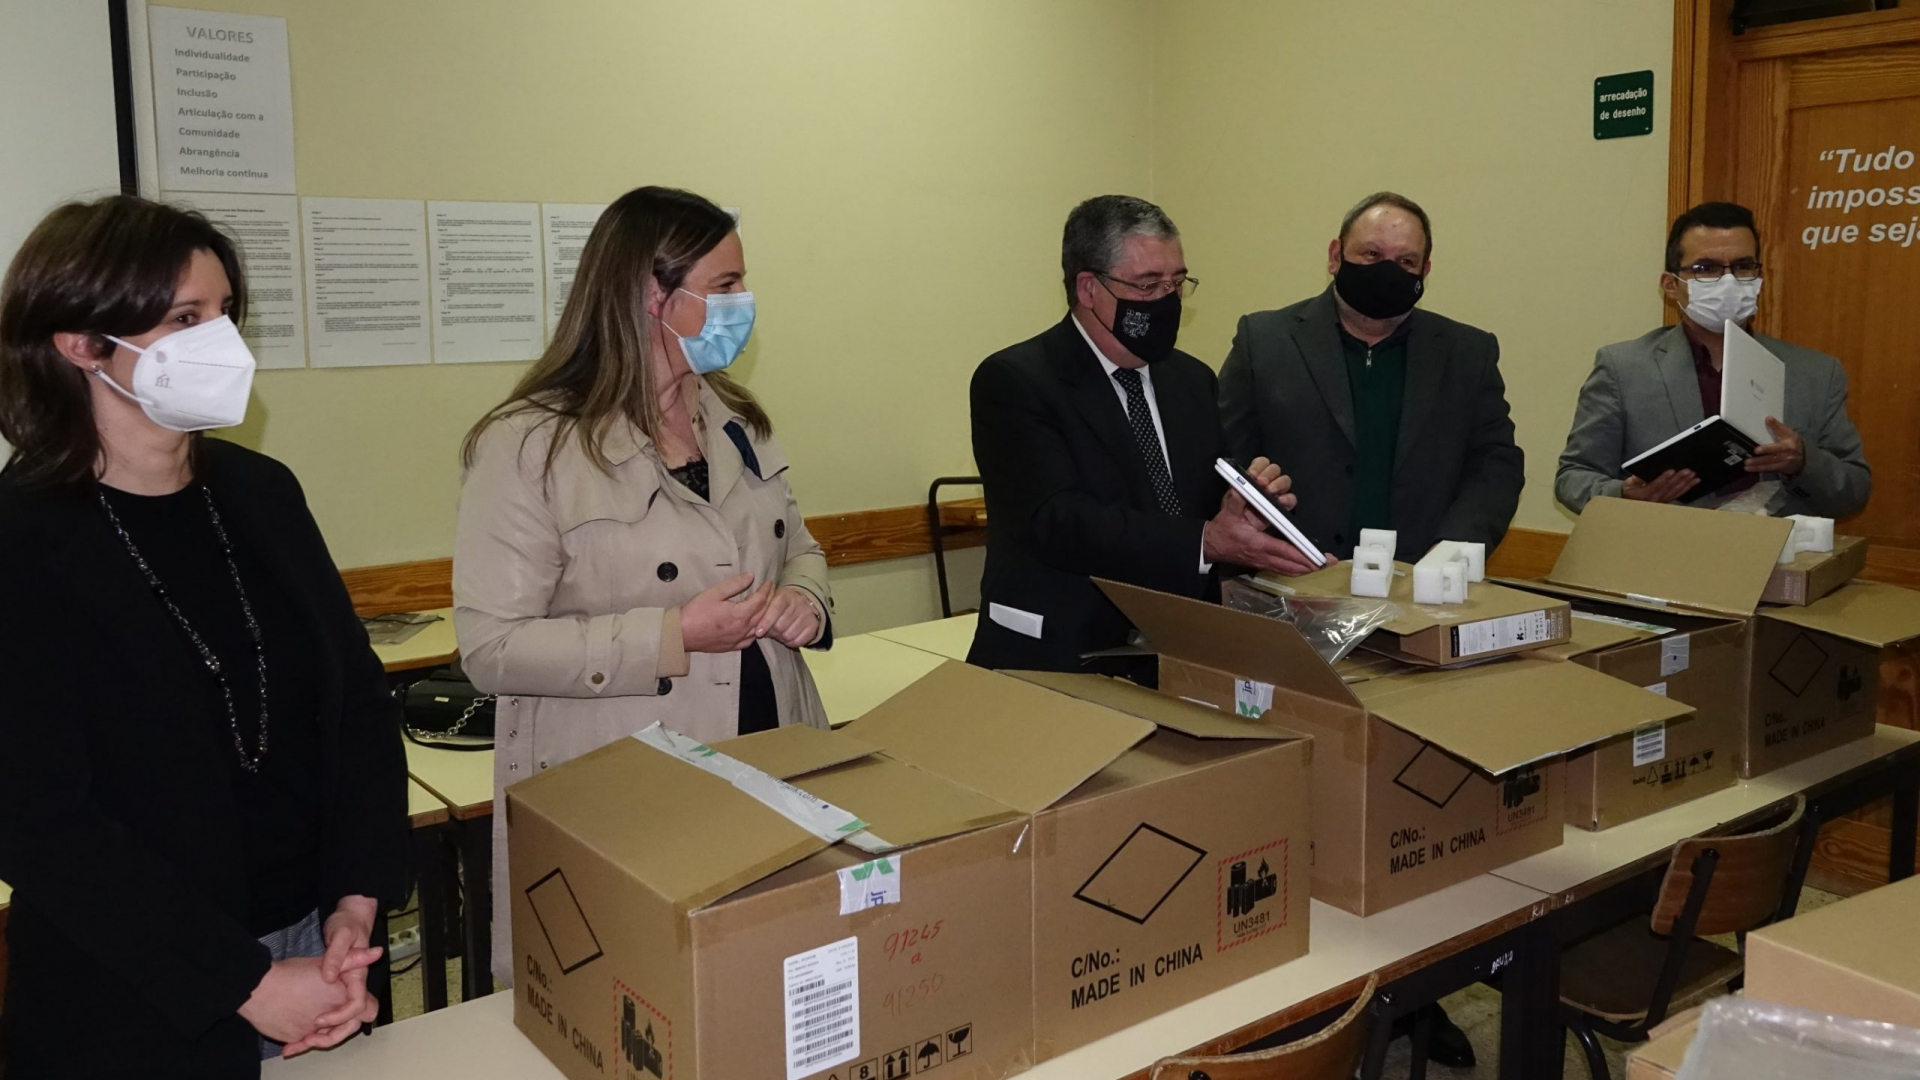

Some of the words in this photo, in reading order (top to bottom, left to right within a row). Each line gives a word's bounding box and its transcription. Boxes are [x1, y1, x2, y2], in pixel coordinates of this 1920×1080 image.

[186, 26, 254, 44] VALORES
[174, 48, 250, 63] Individualidade
[176, 67, 237, 82] Participação
[177, 87, 218, 99] Inclusão
[1600, 87, 1647, 103] arrecadação
[178, 107, 233, 121] Articulação
[235, 112, 256, 121] com
[258, 113, 264, 121] a
[1600, 110, 1610, 121] de
[1612, 106, 1647, 119] desenho
[179, 127, 241, 139] Comunidade
[179, 146, 240, 159] Abrangência
[180, 166, 225, 177] Melhoria
[1802, 224, 1859, 250] que
[1390, 847, 1426, 875] MADE
[1432, 841, 1444, 861] IN
[1450, 827, 1486, 854] CHINA
[1233, 910, 1271, 935] UN3481
[883, 919, 944, 962] 91245
[1071, 973, 1121, 1010] MADE
[1130, 964, 1145, 988] IN
[1154, 943, 1204, 978] CHINA
[526, 983, 554, 1026] MADE
[557, 1012, 568, 1039] IN
[572, 1028, 605, 1075] CHINA
